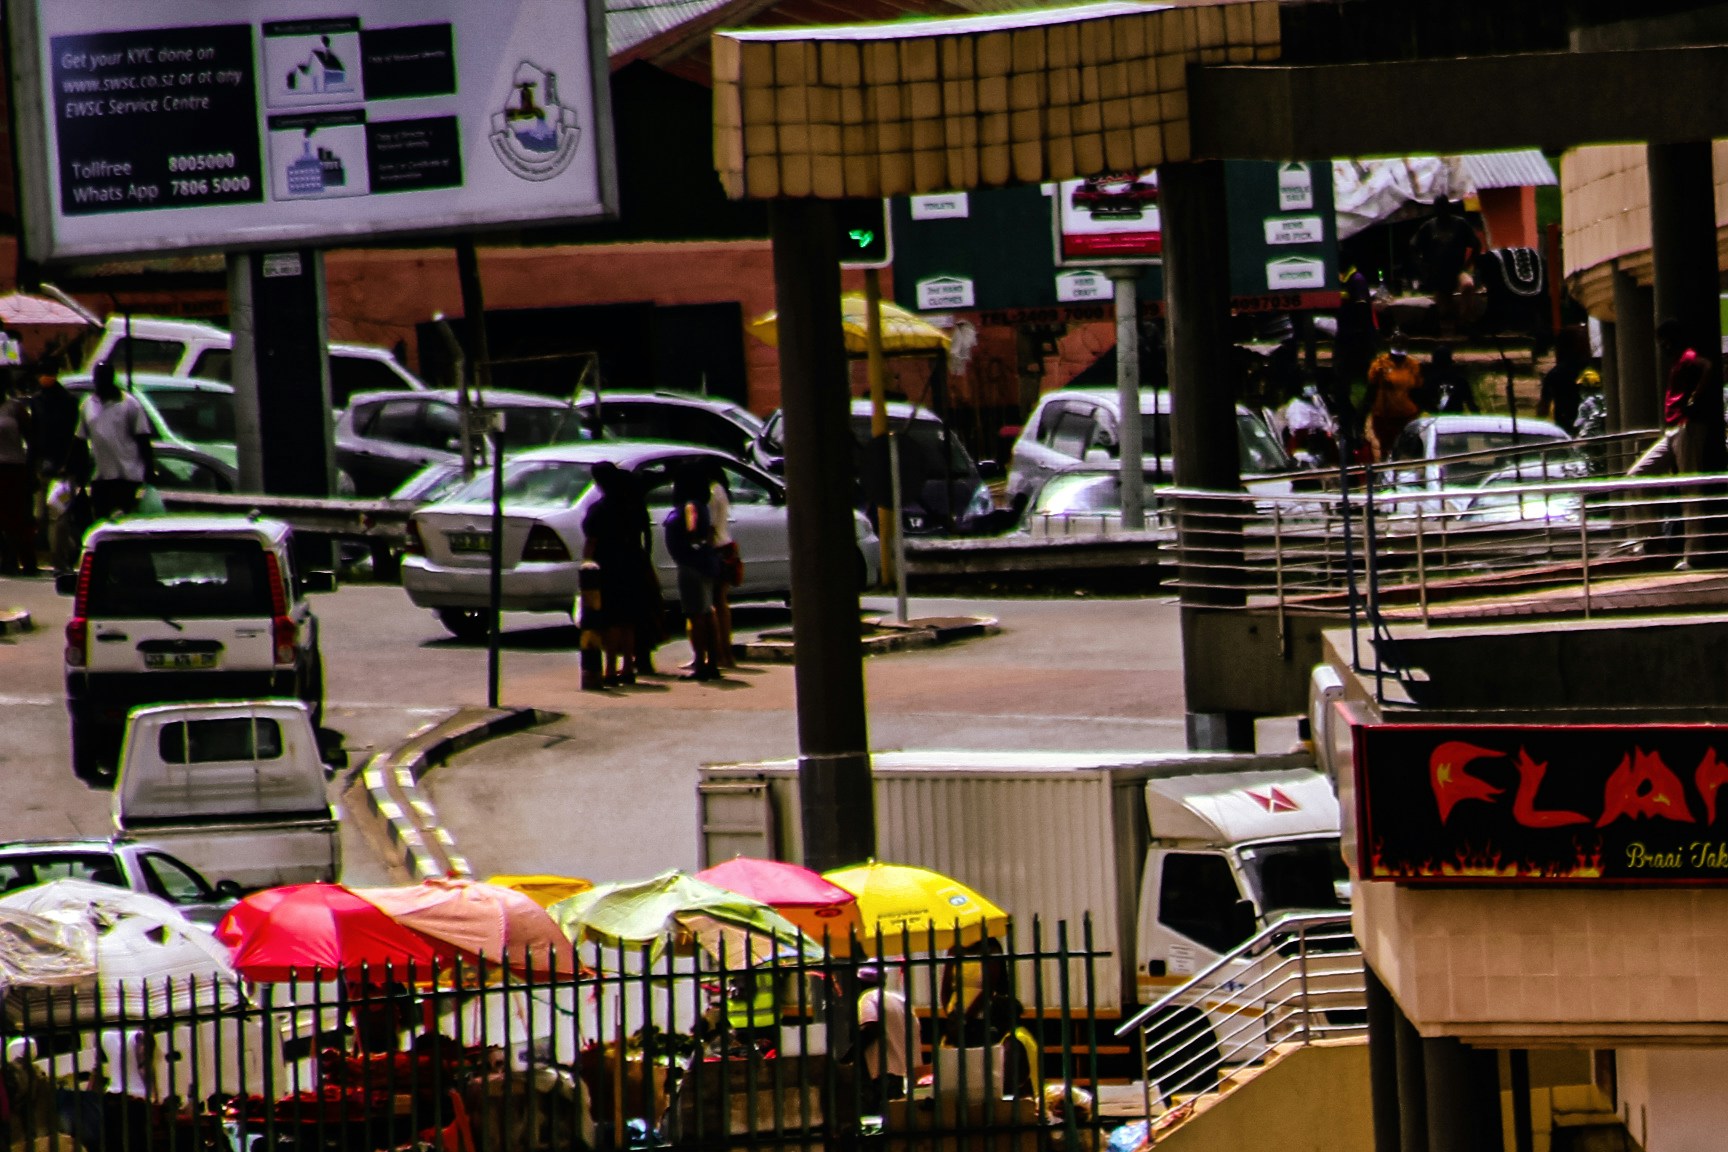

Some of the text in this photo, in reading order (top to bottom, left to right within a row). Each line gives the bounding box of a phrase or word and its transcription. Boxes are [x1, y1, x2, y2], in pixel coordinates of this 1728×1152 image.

[61, 47, 214, 71] Get your KYC done on
[179, 73, 194, 86] or
[198, 70, 212, 83] at
[216, 70, 242, 86] any
[65, 96, 209, 118] EWSC Service Centre
[72, 152, 236, 178] Tollfree 8005000
[73, 176, 250, 202] Whats App 7806 5000
[1625, 842, 1683, 868] Braai
